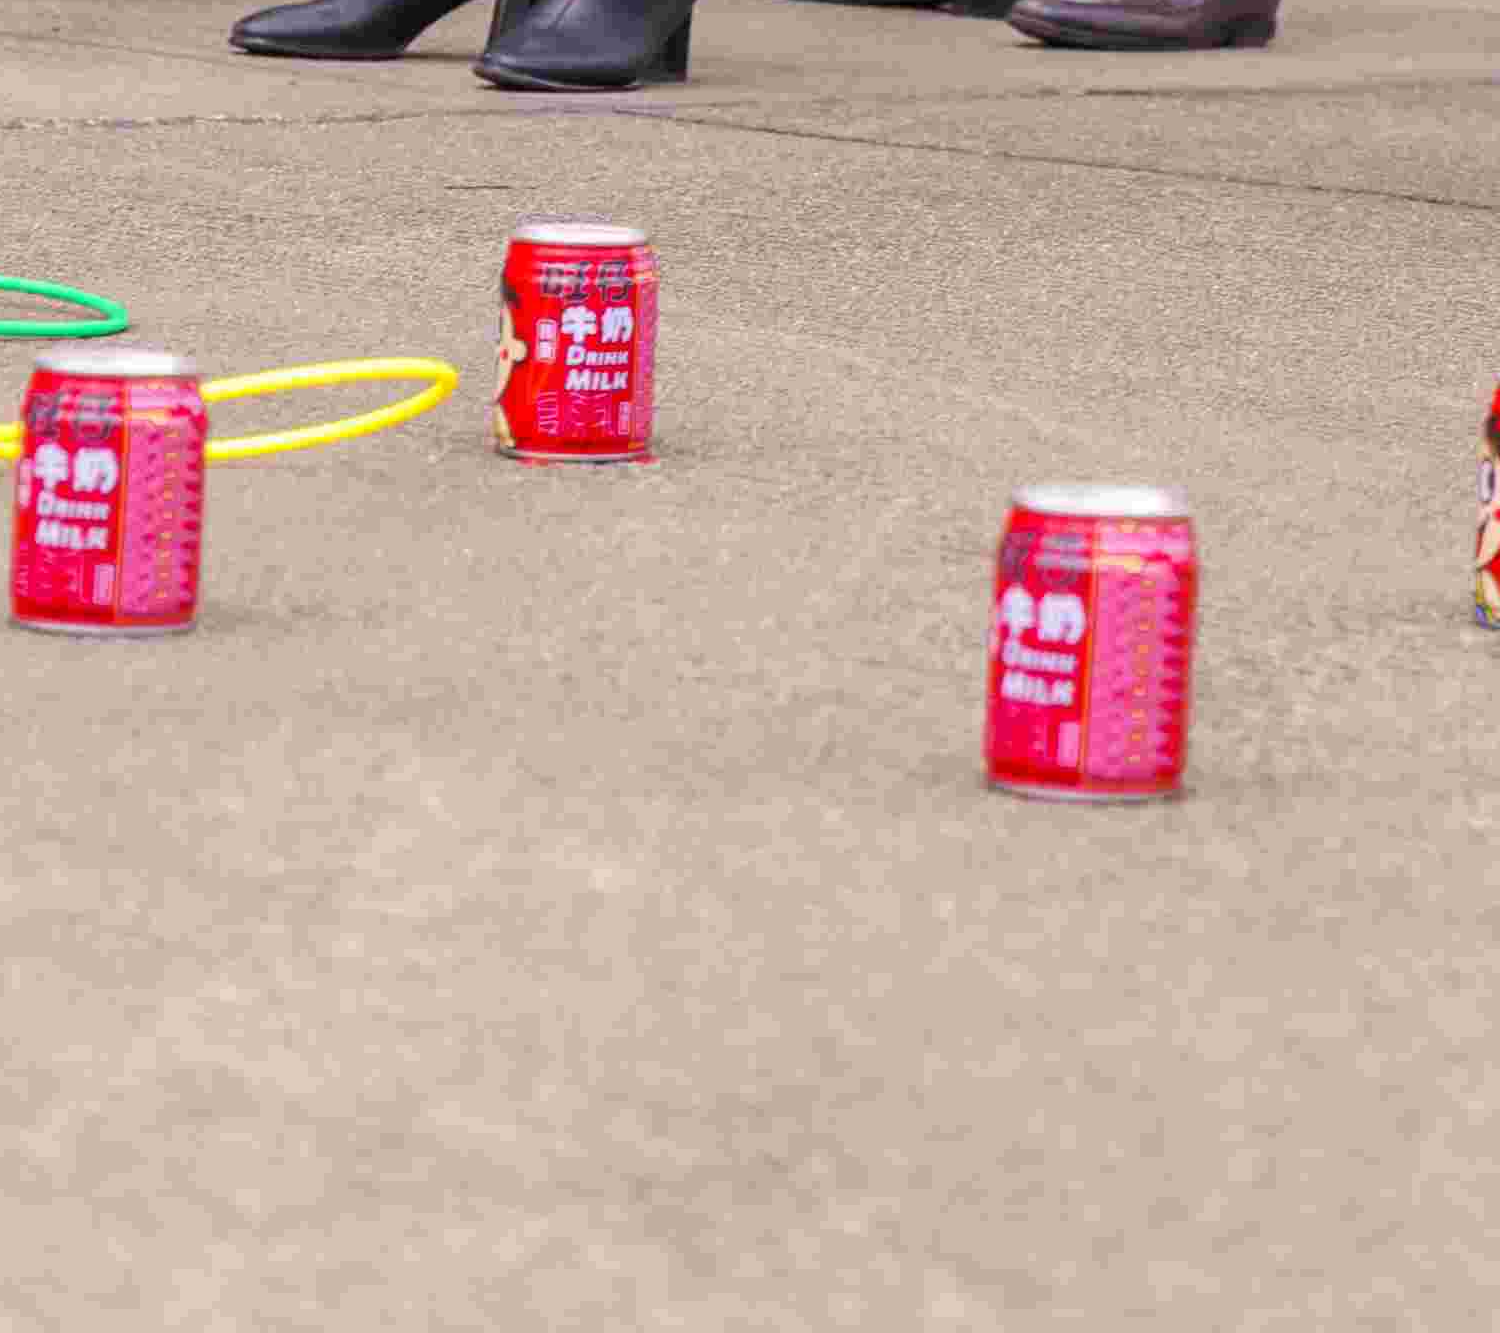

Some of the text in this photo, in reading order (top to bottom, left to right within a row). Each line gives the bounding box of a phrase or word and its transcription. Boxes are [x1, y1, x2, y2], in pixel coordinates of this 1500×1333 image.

[561, 305, 634, 344] 牛奶
[565, 344, 629, 366] DRINK
[564, 368, 629, 392] MILK
[33, 443, 120, 495] 牛奶
[35, 517, 109, 550] MILK
